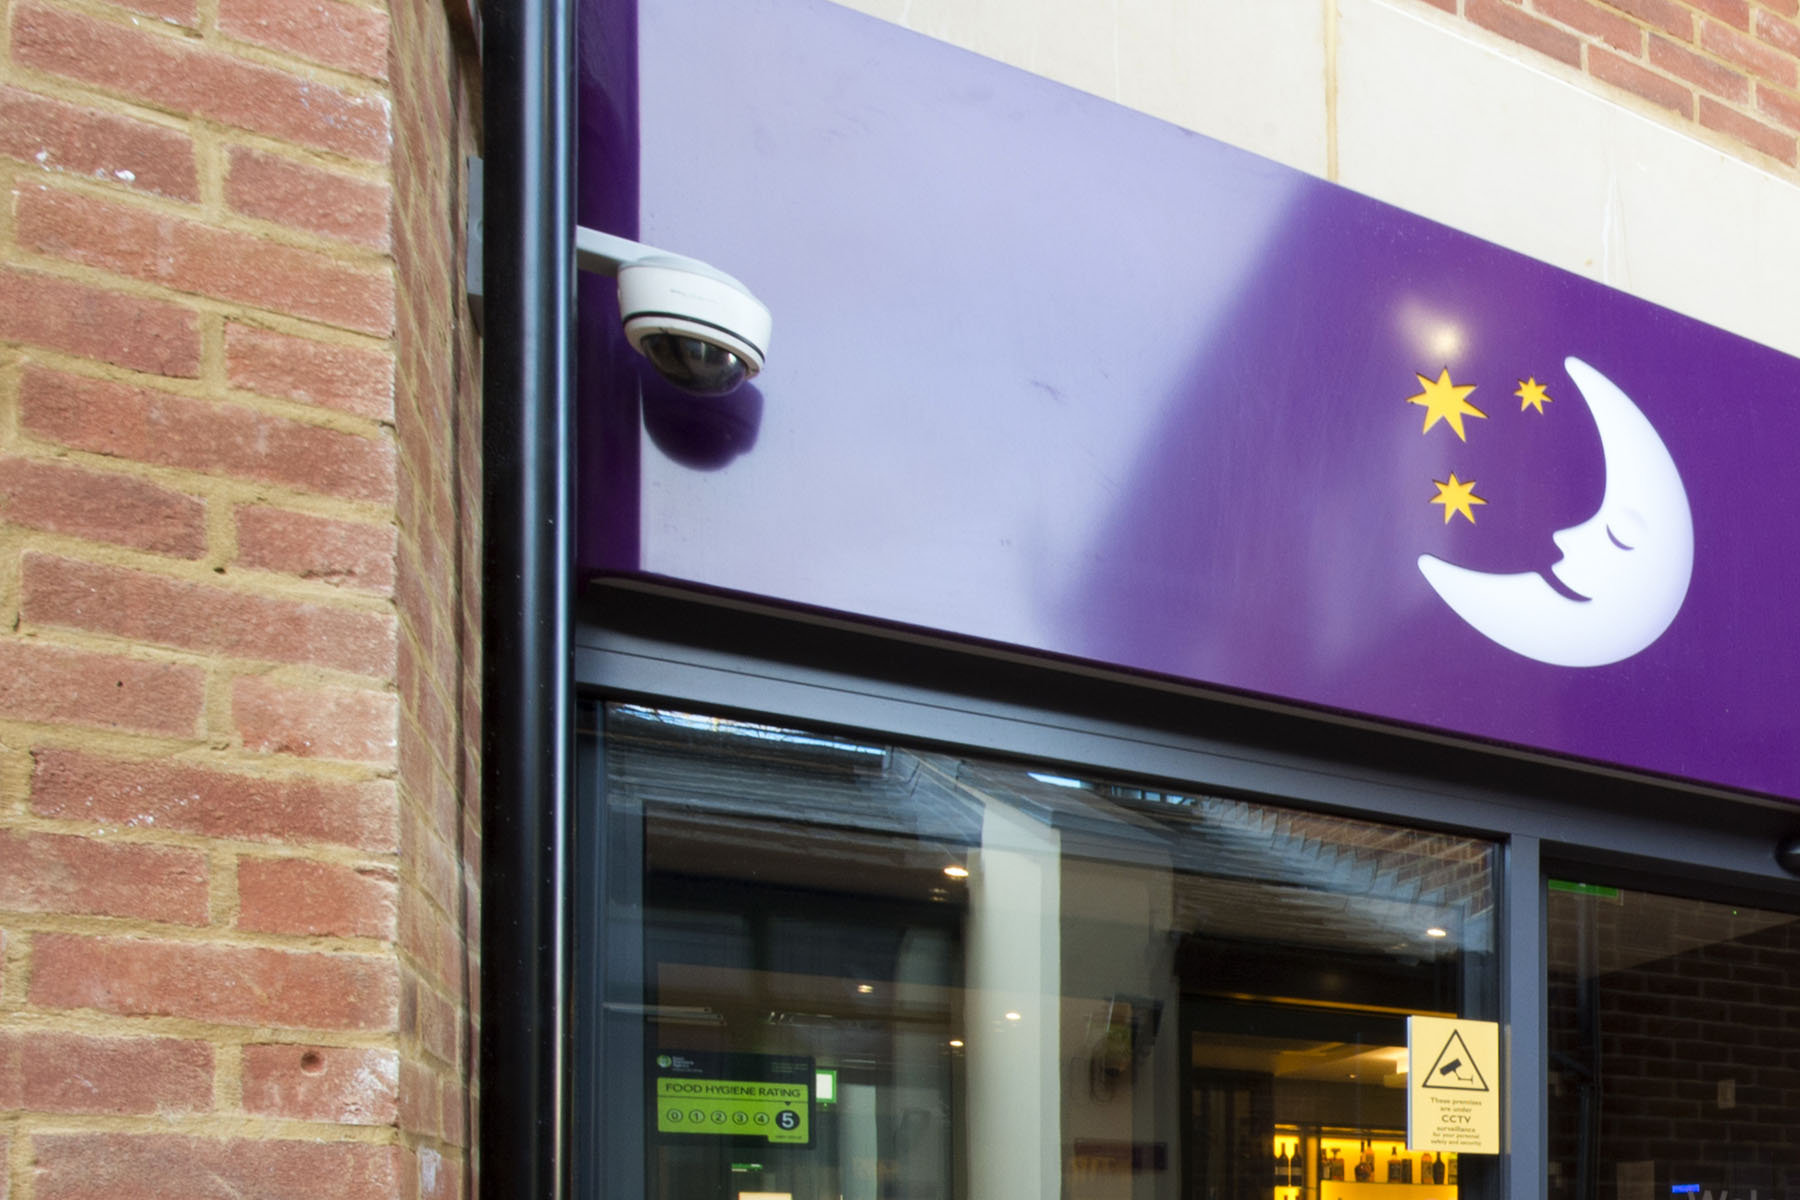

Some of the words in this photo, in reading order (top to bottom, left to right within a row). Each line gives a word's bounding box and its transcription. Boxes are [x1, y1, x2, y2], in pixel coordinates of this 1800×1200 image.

[665, 1083, 703, 1094] FOOD
[705, 1084, 756, 1097] HYGIENE
[758, 1086, 801, 1098] RATING
[1431, 1096, 1450, 1104] These
[781, 1113, 794, 1129] 5
[1441, 1114, 1471, 1124] CCTV
